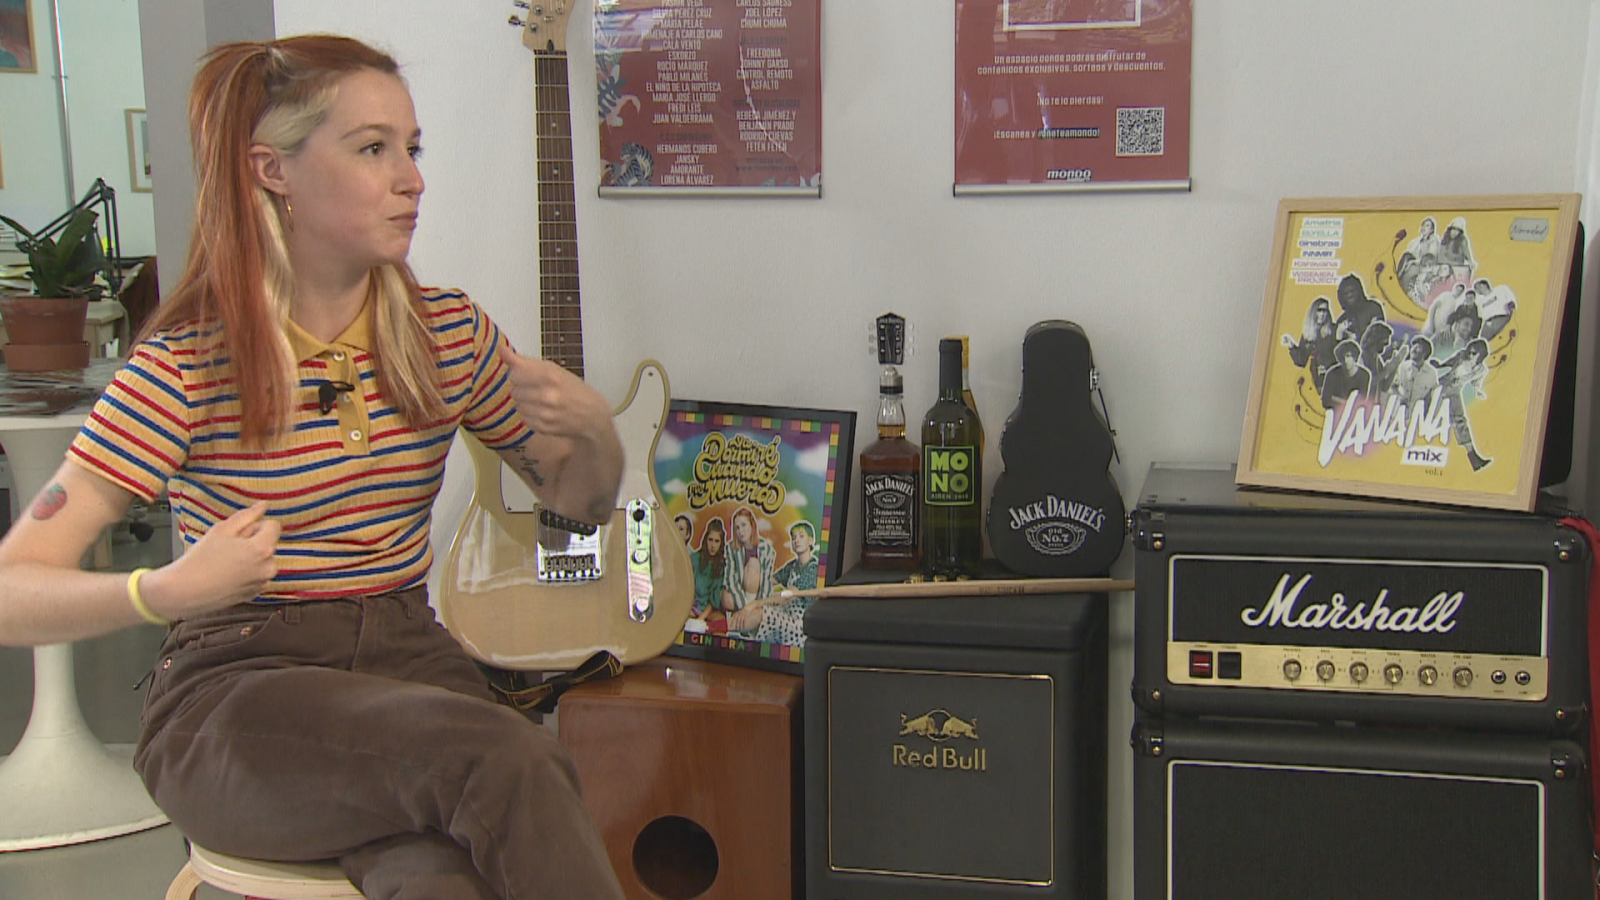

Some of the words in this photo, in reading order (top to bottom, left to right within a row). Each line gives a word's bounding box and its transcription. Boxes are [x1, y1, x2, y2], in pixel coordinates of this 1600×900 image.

[696, 8, 712, 18] CRUZ
[763, 6, 782, 17] LÓPEZ
[642, 29, 674, 39] HOMENAJE
[682, 29, 705, 39] CARLOS
[706, 29, 723, 39] CANO
[662, 40, 680, 50] CALA
[681, 40, 701, 50] VENTO
[747, 48, 782, 58] FREEDONIA
[994, 55, 1006, 64] Un
[1006, 55, 1038, 63] espacio
[1039, 54, 1065, 63] donde
[1096, 51, 1134, 62] disfrutar
[1135, 51, 1146, 61] de
[736, 69, 764, 79] CONTROL
[766, 69, 793, 79] REMOTO
[977, 65, 1023, 75] contenidos
[1073, 63, 1106, 73] sorteos
[658, 71, 678, 81] PABLO
[646, 82, 654, 92] EL
[672, 82, 682, 92] DE
[682, 82, 691, 92] LA
[692, 82, 722, 92] HIPOTECA
[751, 80, 779, 91] ASFALTO
[1051, 97, 1060, 105] te
[1060, 97, 1069, 105] lo
[687, 102, 701, 113] LEIS
[653, 113, 669, 123] JUAN
[670, 113, 713, 124] VALDERRAMA
[773, 120, 795, 130] PRADO
[740, 131, 768, 141] RODRIGO
[768, 131, 794, 141] CUEVAS
[657, 144, 692, 153] HERMANOS
[693, 144, 718, 153] CUBERO
[675, 154, 700, 164] JANSKY
[670, 164, 704, 174] AMORANTE
[660, 174, 685, 185] LORENA
[1317, 384, 1452, 468] VANANA
[1406, 447, 1443, 464] mix
[694, 452, 779, 487] Cuando
[866, 483, 885, 496] JACK
[690, 478, 787, 515] Muera
[1008, 501, 1047, 530] JACK
[1241, 572, 1465, 634] Marshall
[892, 743, 938, 769] Red
[942, 746, 988, 772] Bull
